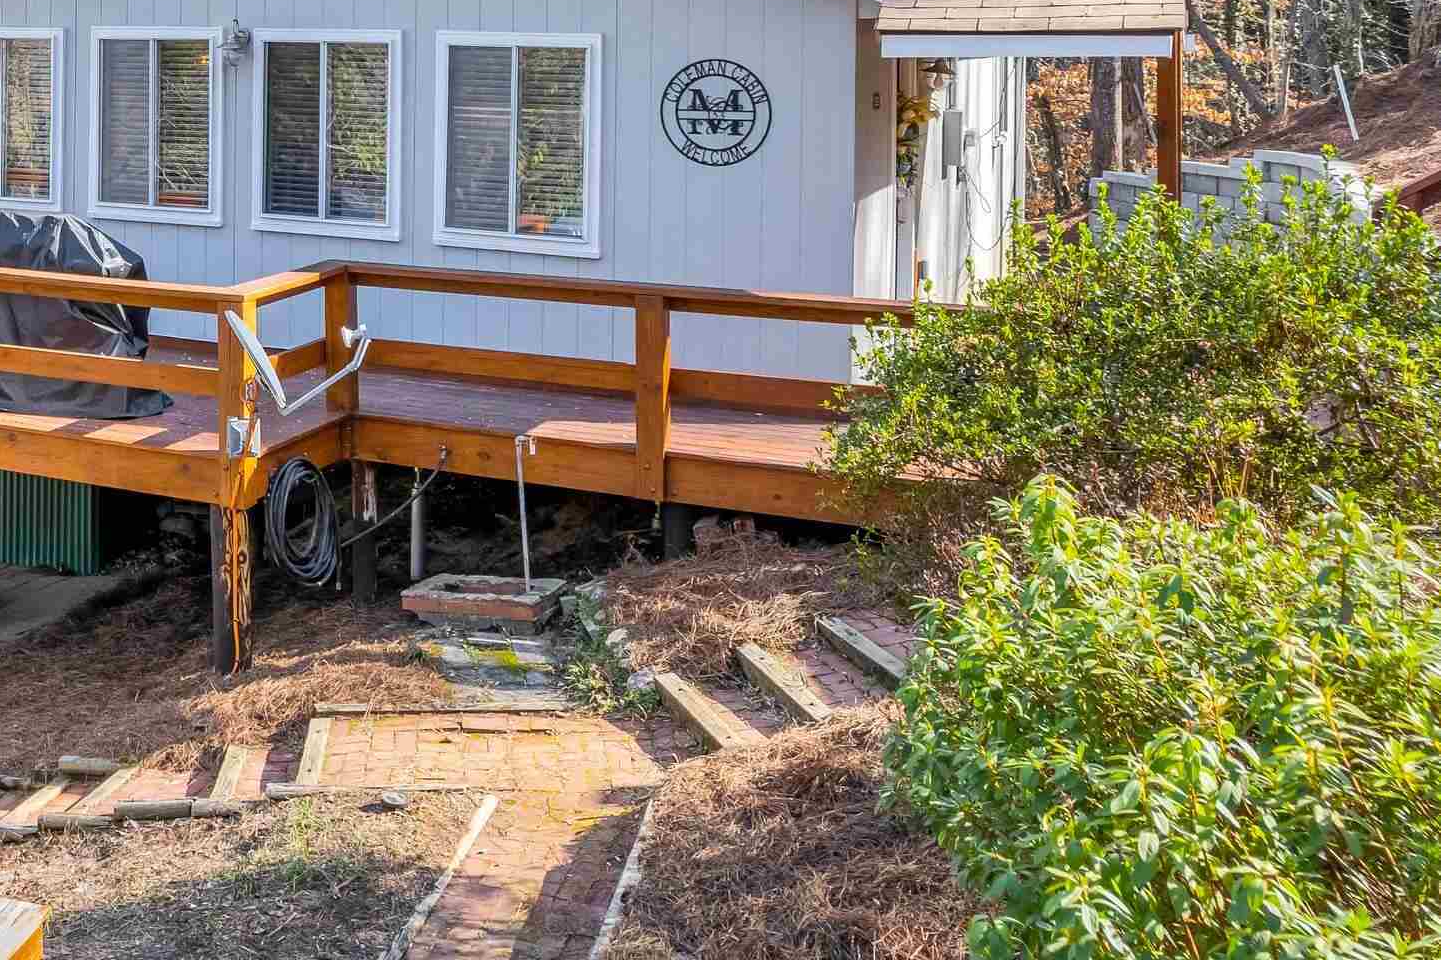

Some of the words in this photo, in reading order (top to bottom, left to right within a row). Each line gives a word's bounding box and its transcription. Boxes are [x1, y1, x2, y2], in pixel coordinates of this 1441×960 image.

[665, 60, 726, 102] COLEMAN
[731, 63, 768, 105] CABIN
[682, 140, 753, 165] WELCOME
